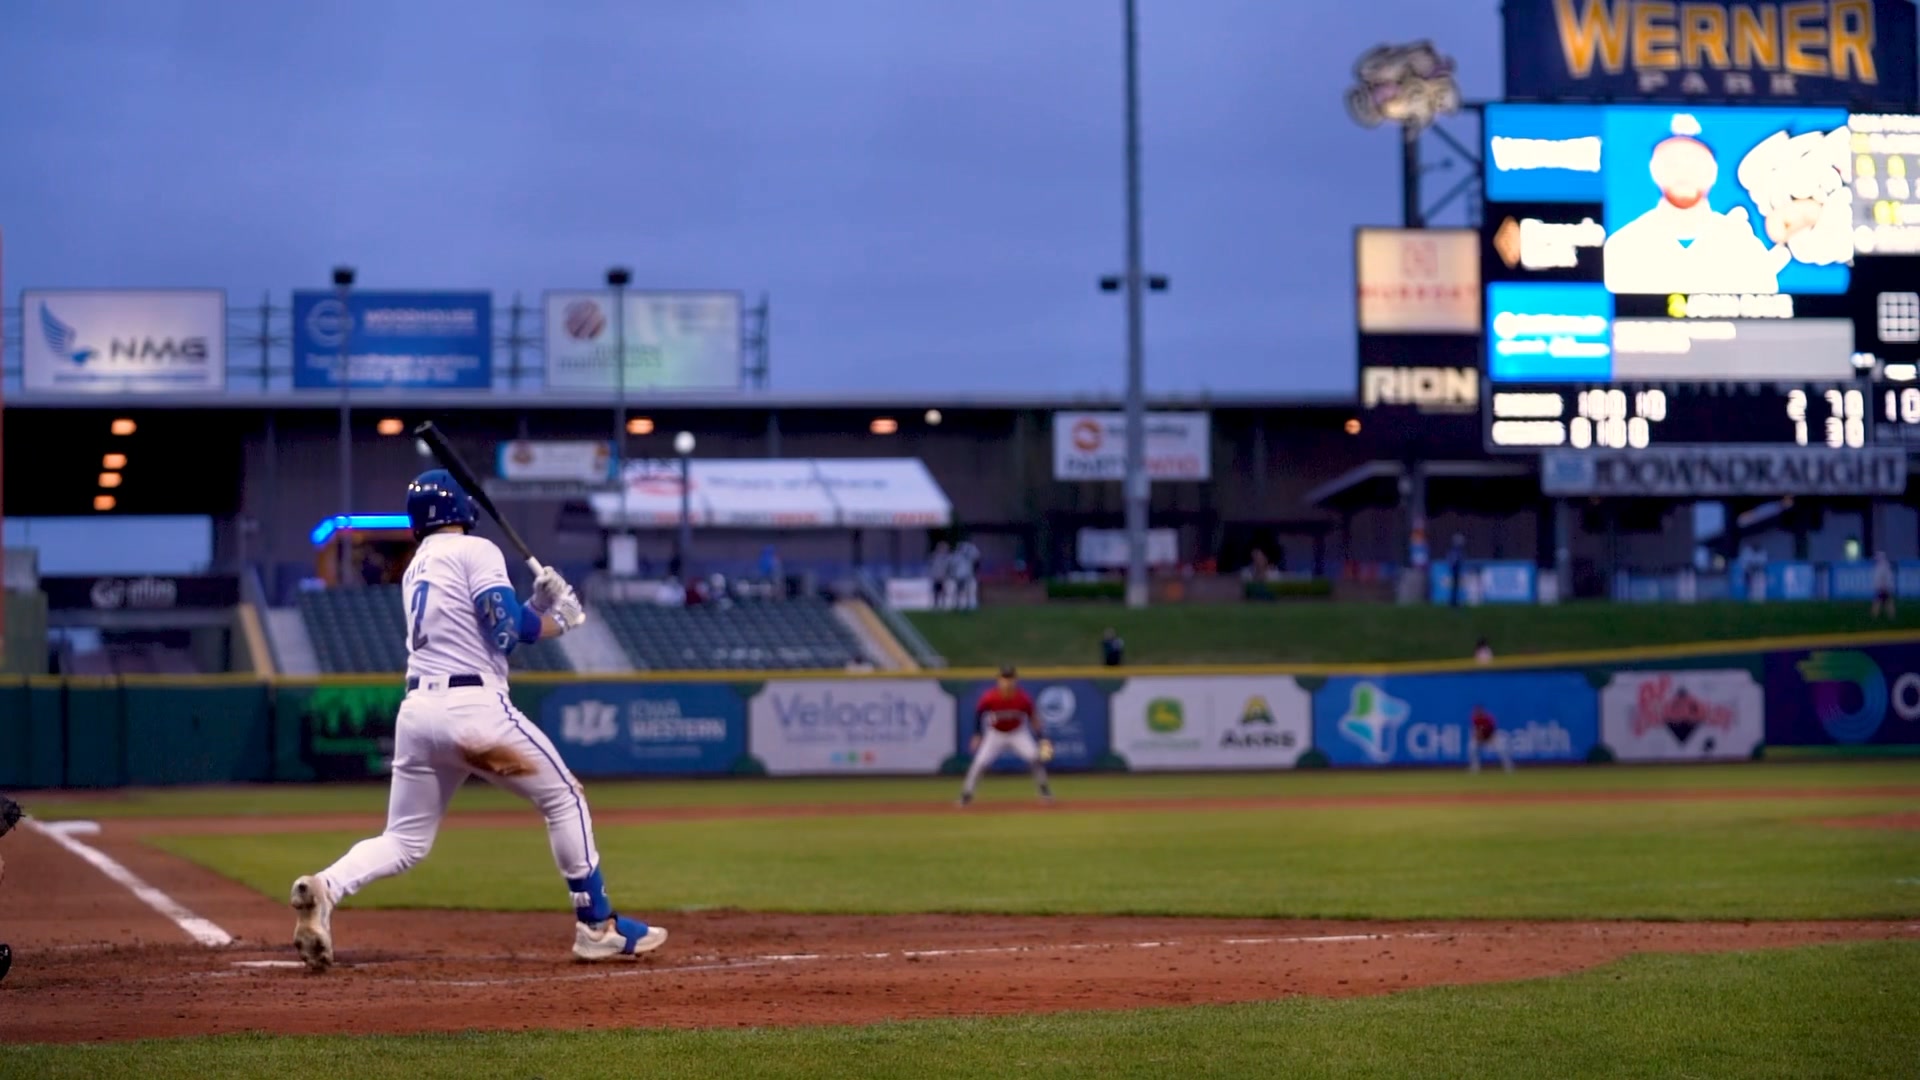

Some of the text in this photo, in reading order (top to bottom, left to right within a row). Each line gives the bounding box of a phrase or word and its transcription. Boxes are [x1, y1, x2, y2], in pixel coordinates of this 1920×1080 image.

[1553, 0, 1878, 84] WERNER
[1638, 71, 1799, 95] PARK
[109, 336, 209, 362] NMG
[411, 580, 430, 651] 2
[772, 690, 935, 740] Velocity
[1406, 722, 1461, 758] CHI
